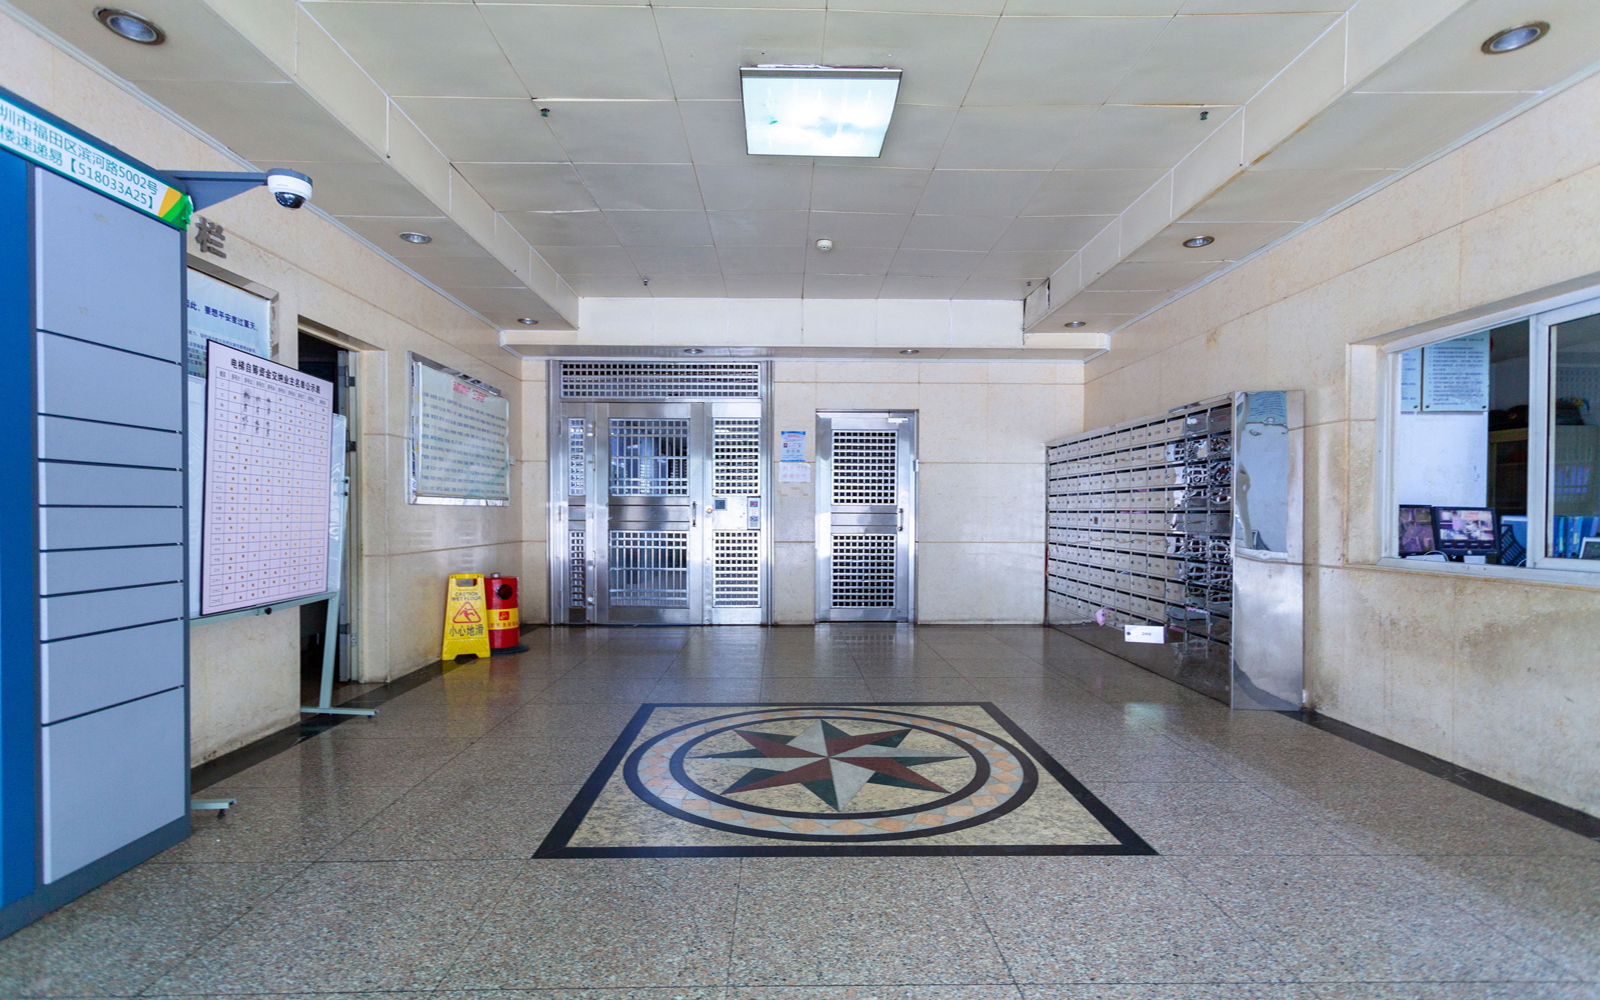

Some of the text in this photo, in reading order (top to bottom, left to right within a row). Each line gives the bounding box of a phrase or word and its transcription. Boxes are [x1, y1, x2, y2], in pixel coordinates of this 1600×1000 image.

[0, 104, 158, 196] 圳市福田区滨河路5002号
[195, 216, 227, 259] 栏
[448, 624, 484, 637] 小心地滑
